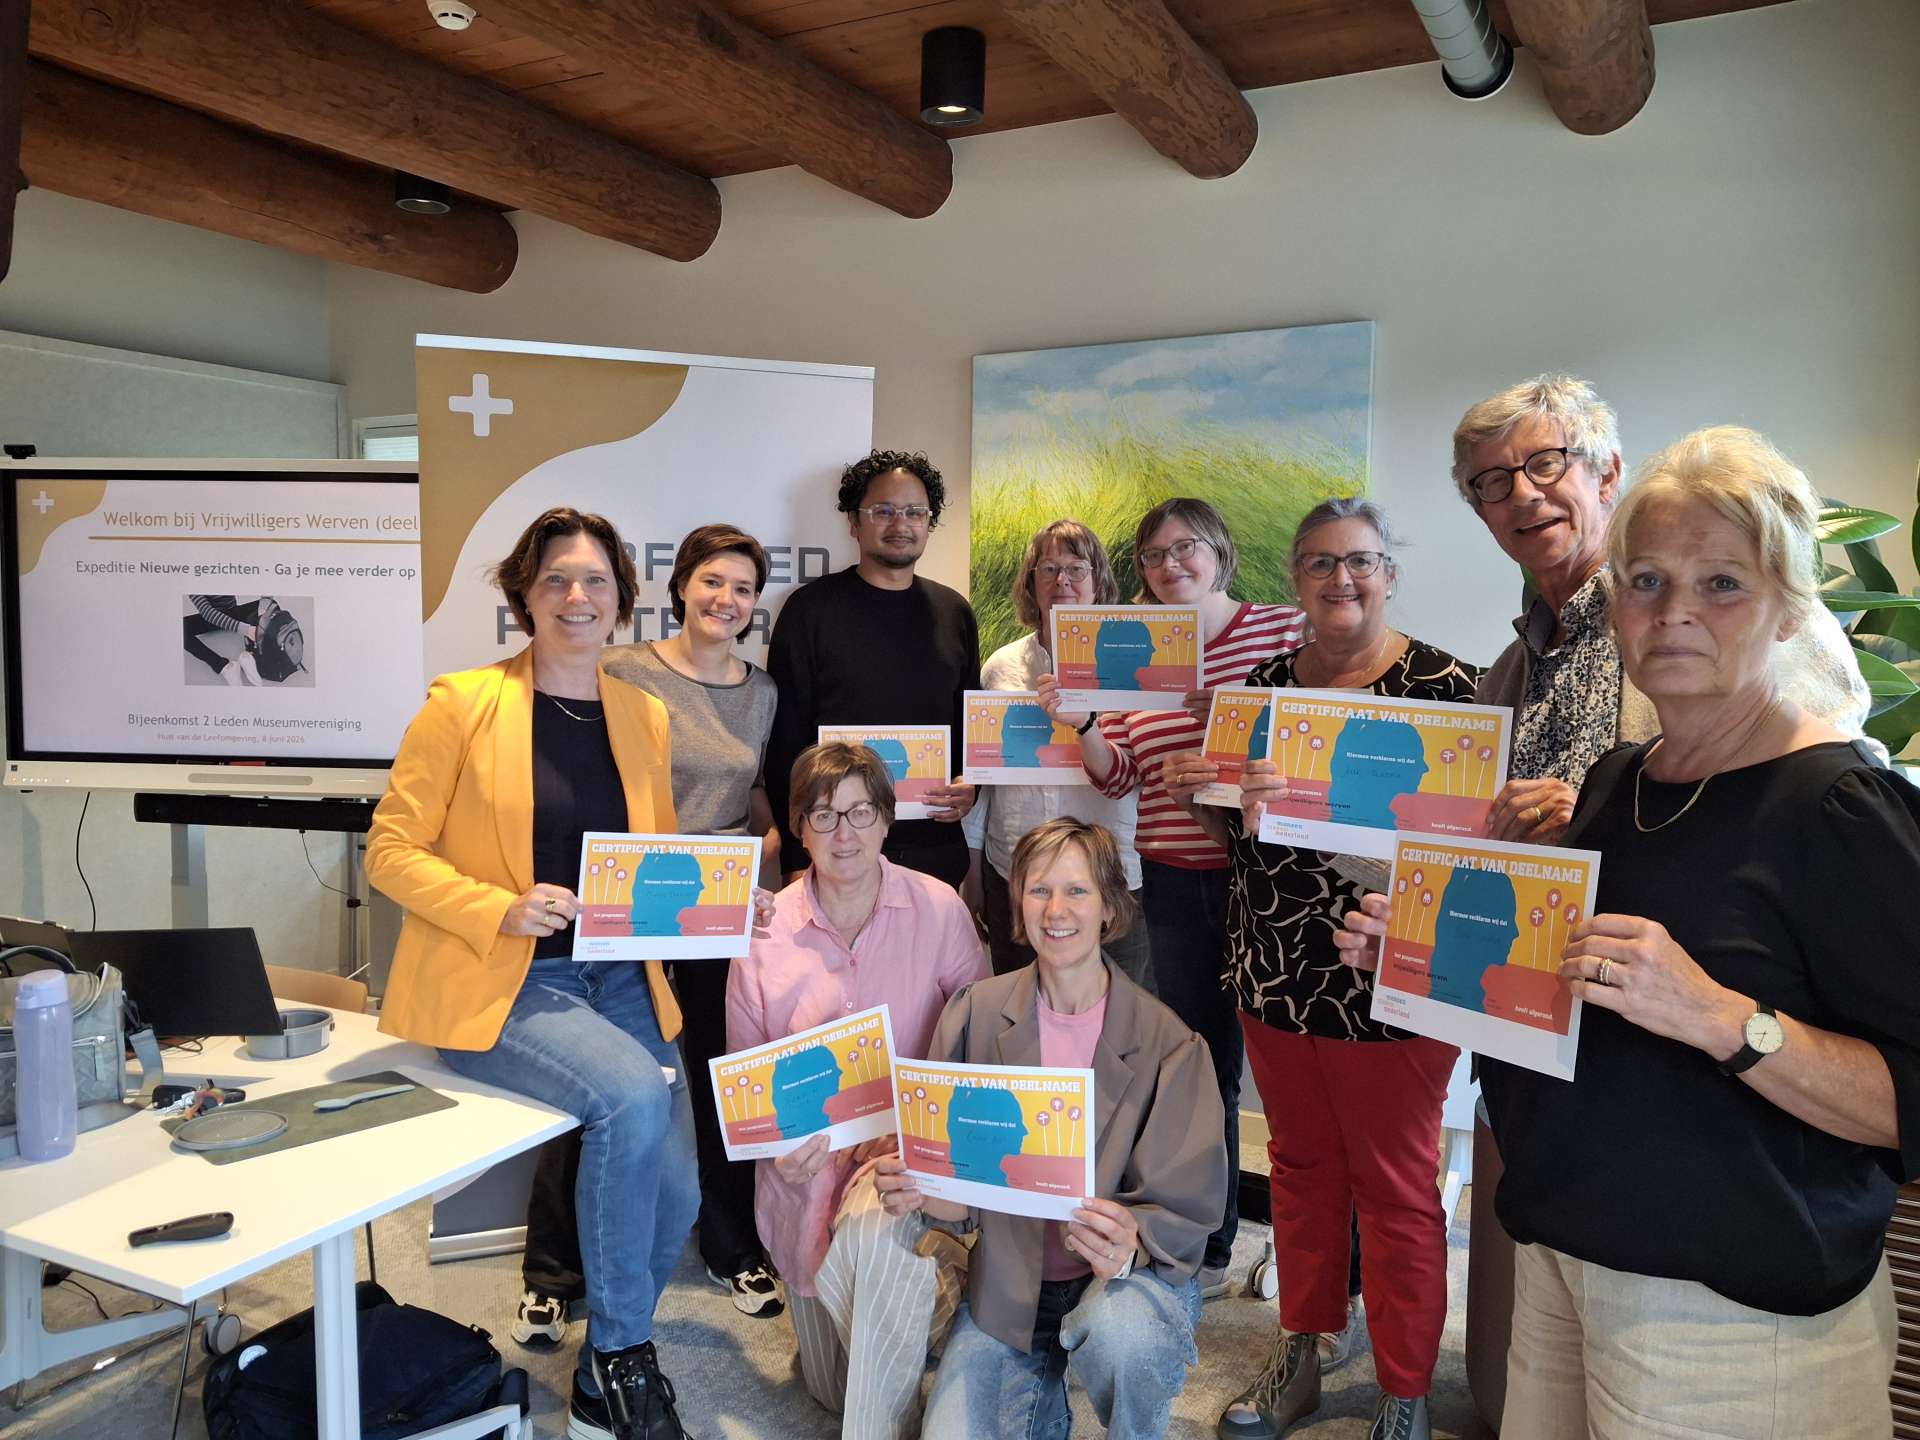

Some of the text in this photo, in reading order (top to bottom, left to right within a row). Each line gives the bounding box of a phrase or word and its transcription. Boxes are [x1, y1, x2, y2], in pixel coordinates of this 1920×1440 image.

[103, 511, 418, 531] Welkom bij Vrijwilligers Werven (deel
[76, 560, 136, 575] Expeditie
[140, 561, 190, 574] Nieuwe
[194, 562, 260, 577] gezichten
[274, 563, 292, 576] Ga
[296, 564, 310, 578] je
[314, 566, 344, 576] mee
[348, 565, 394, 577] verder
[399, 568, 416, 580] op
[1059, 613, 1119, 622] CERTIFICAAT
[1122, 614, 1141, 622] VAN
[1027, 698, 1039, 706] VA
[127, 713, 362, 732] Bijeenkomst 2 Leden Museumvereniging
[1281, 701, 1496, 732] CERTIFICAAT VAN DEELNAME
[592, 843, 667, 855] CERTIFICAAT
[668, 845, 691, 855] VAN
[1401, 847, 1583, 884] CERTIFICAAT VAN DEELNAME
[720, 1017, 880, 1077] CERTIFICAAT VAN DEELNAME
[899, 1069, 1081, 1094] CERTIFICAAT VAN DEELNAME
